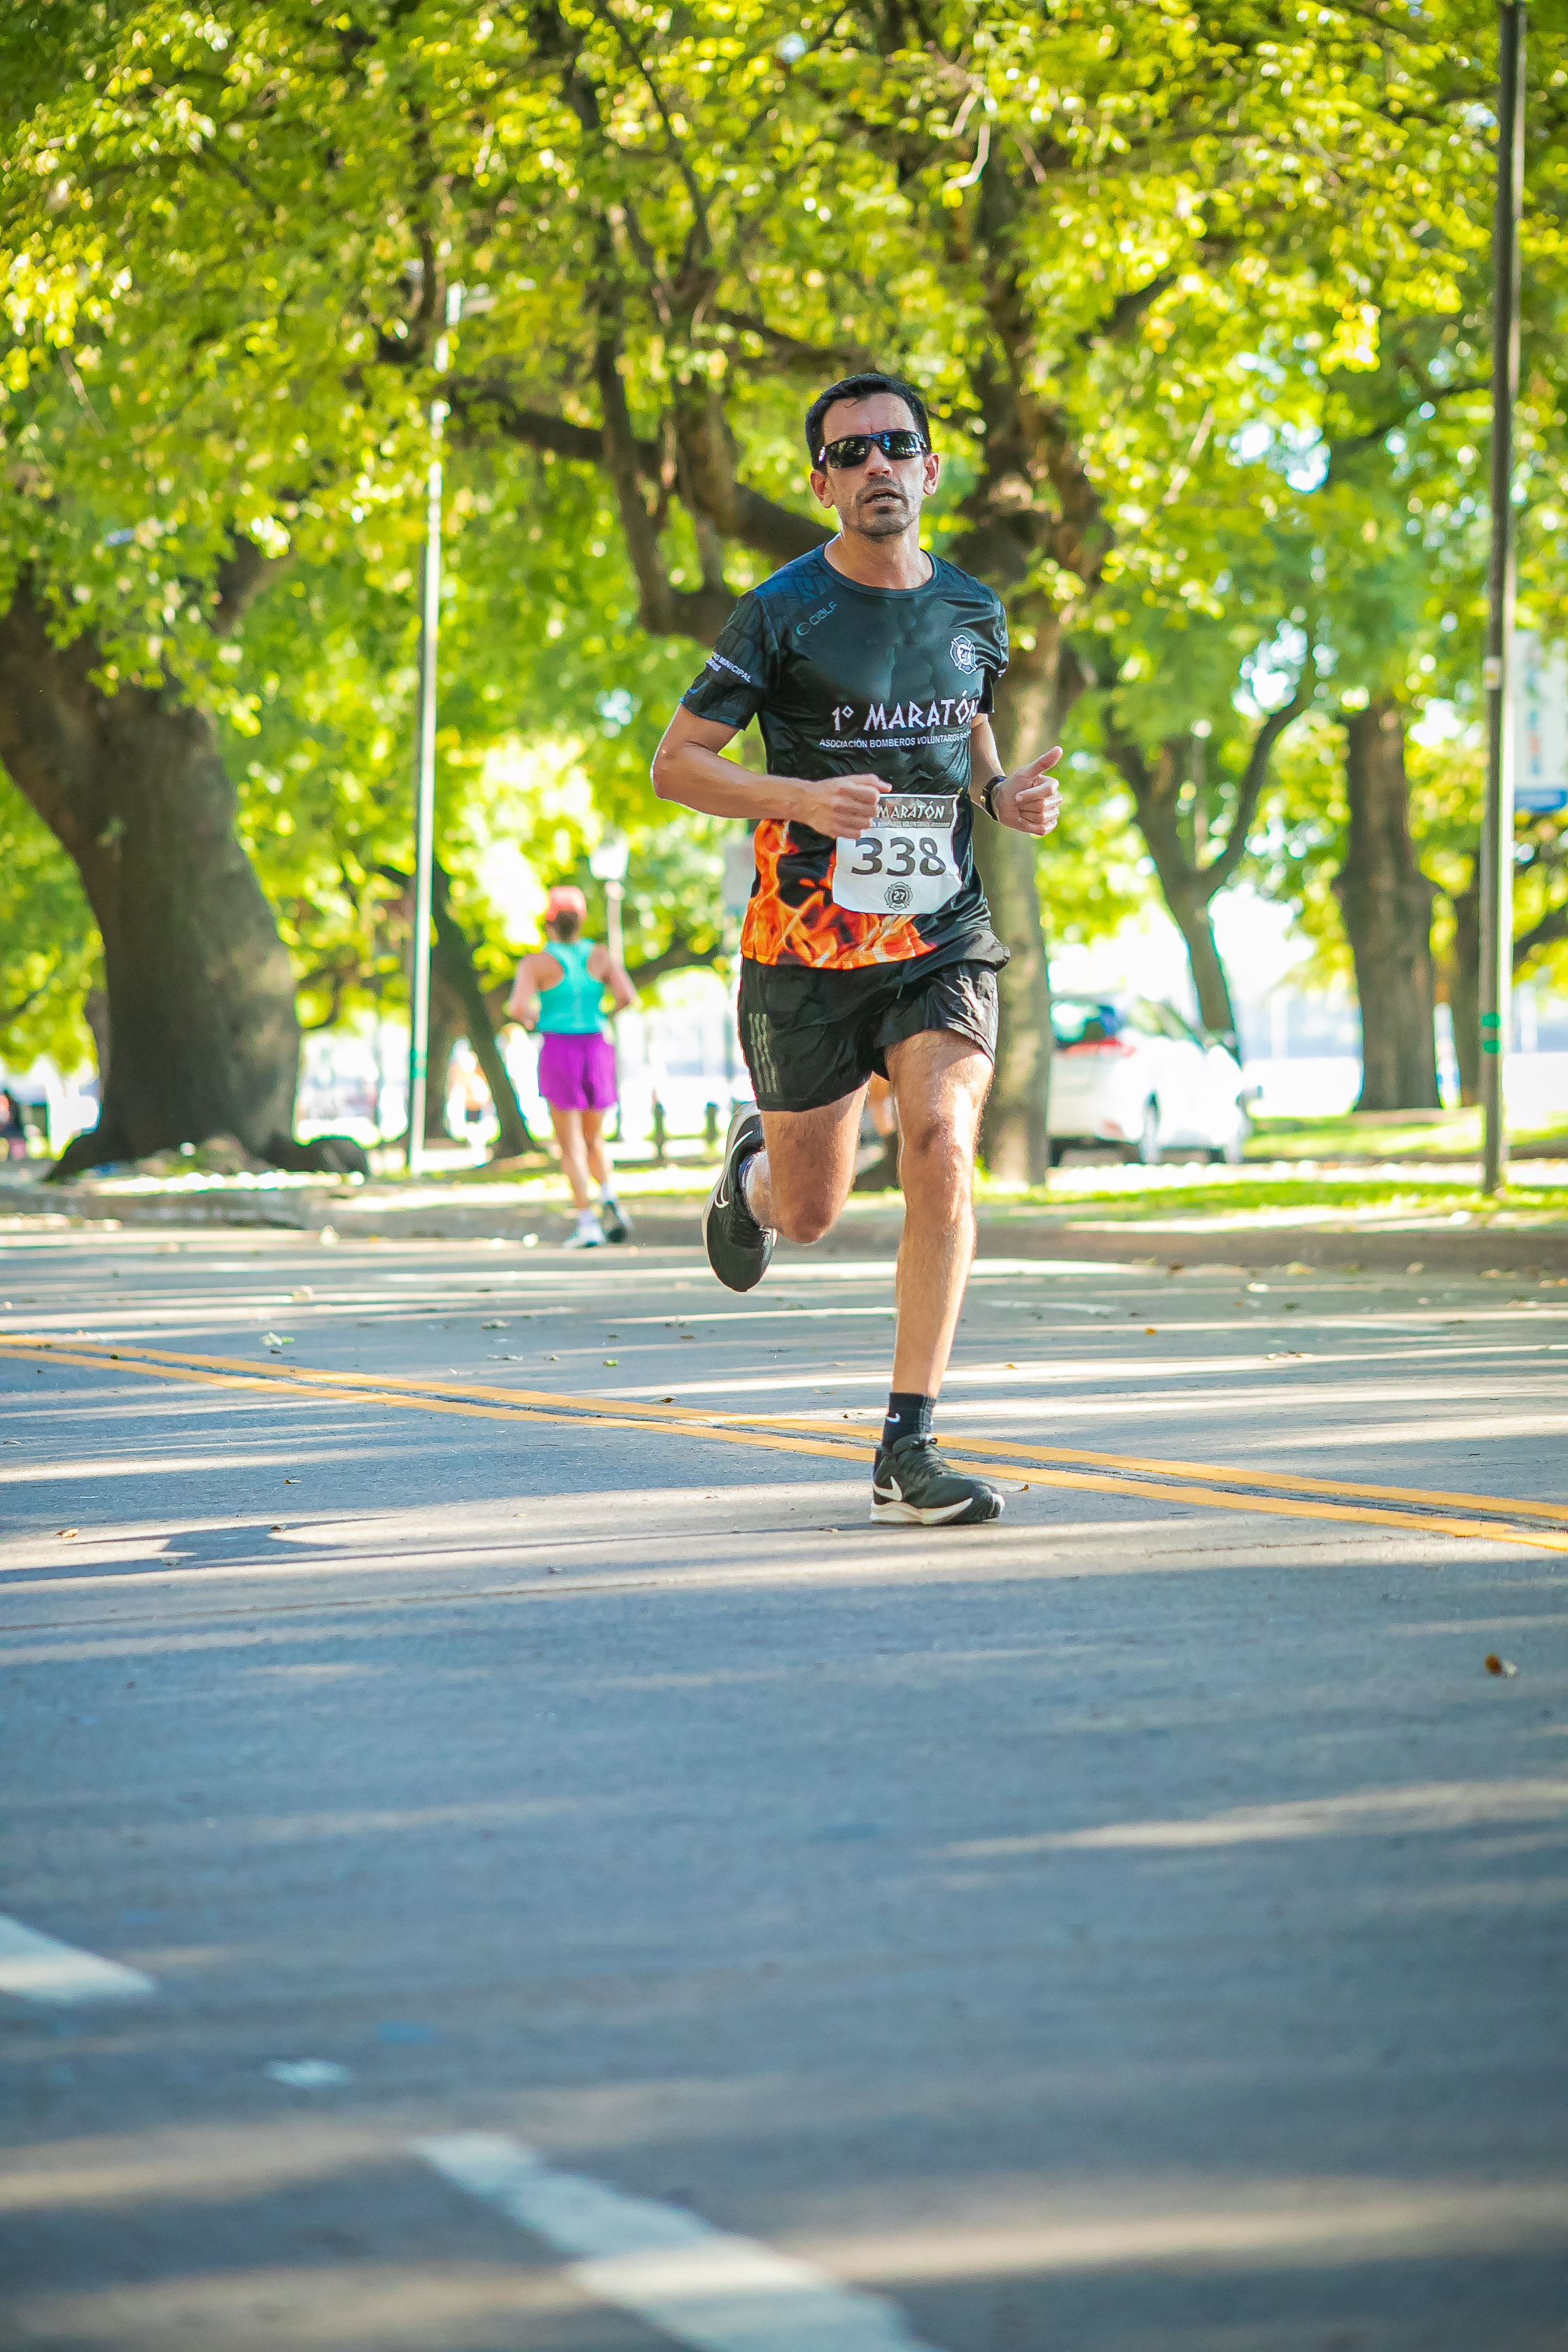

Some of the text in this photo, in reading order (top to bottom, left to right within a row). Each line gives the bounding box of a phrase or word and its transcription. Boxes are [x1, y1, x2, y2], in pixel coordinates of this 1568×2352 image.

[863, 689, 979, 732] MARATÓN
[818, 737, 868, 749] ASOCIACIÓN
[869, 736, 916, 748] BOMBEROS
[917, 733, 960, 745] VOLUNTARIOS
[876, 800, 945, 820] MARATÓN
[850, 836, 946, 876] 338
[893, 890, 906, 901] 27
